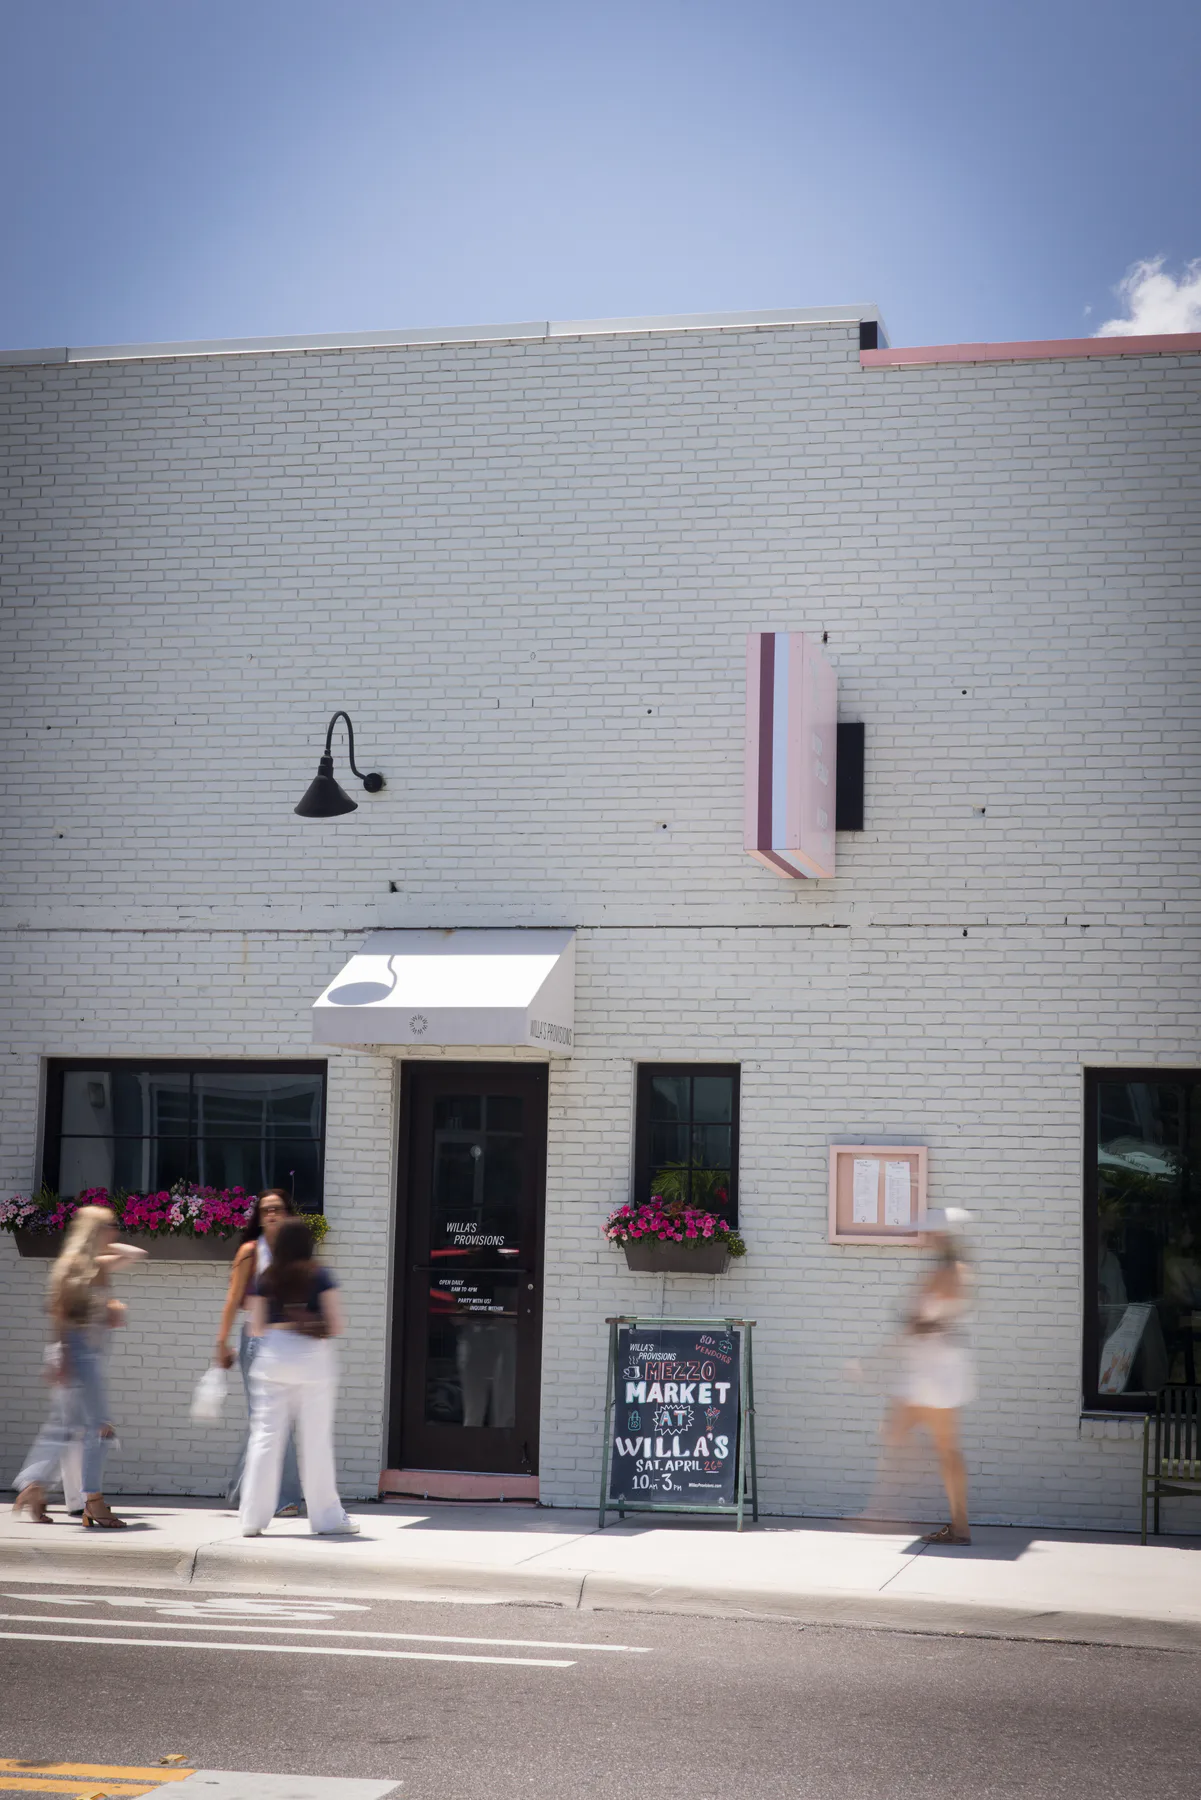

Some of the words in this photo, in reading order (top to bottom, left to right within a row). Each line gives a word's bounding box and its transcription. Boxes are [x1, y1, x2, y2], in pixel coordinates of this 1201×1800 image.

[530, 1020, 546, 1039] WILLA'S
[547, 1023, 572, 1045] PROVISIONS
[446, 1222, 478, 1233] WILLA'S
[453, 1235, 504, 1245] PROVISIONS
[700, 1334, 716, 1345] 80+
[629, 1343, 655, 1352] WILLA'S
[695, 1344, 732, 1365] VENDORS
[638, 1352, 677, 1361] PROVISIONS
[644, 1360, 716, 1381] MEZZO
[625, 1381, 731, 1404] MARKET
[660, 1410, 687, 1427] AT
[615, 1432, 729, 1459] WILLA'S
[664, 1460, 702, 1472] APRIL
